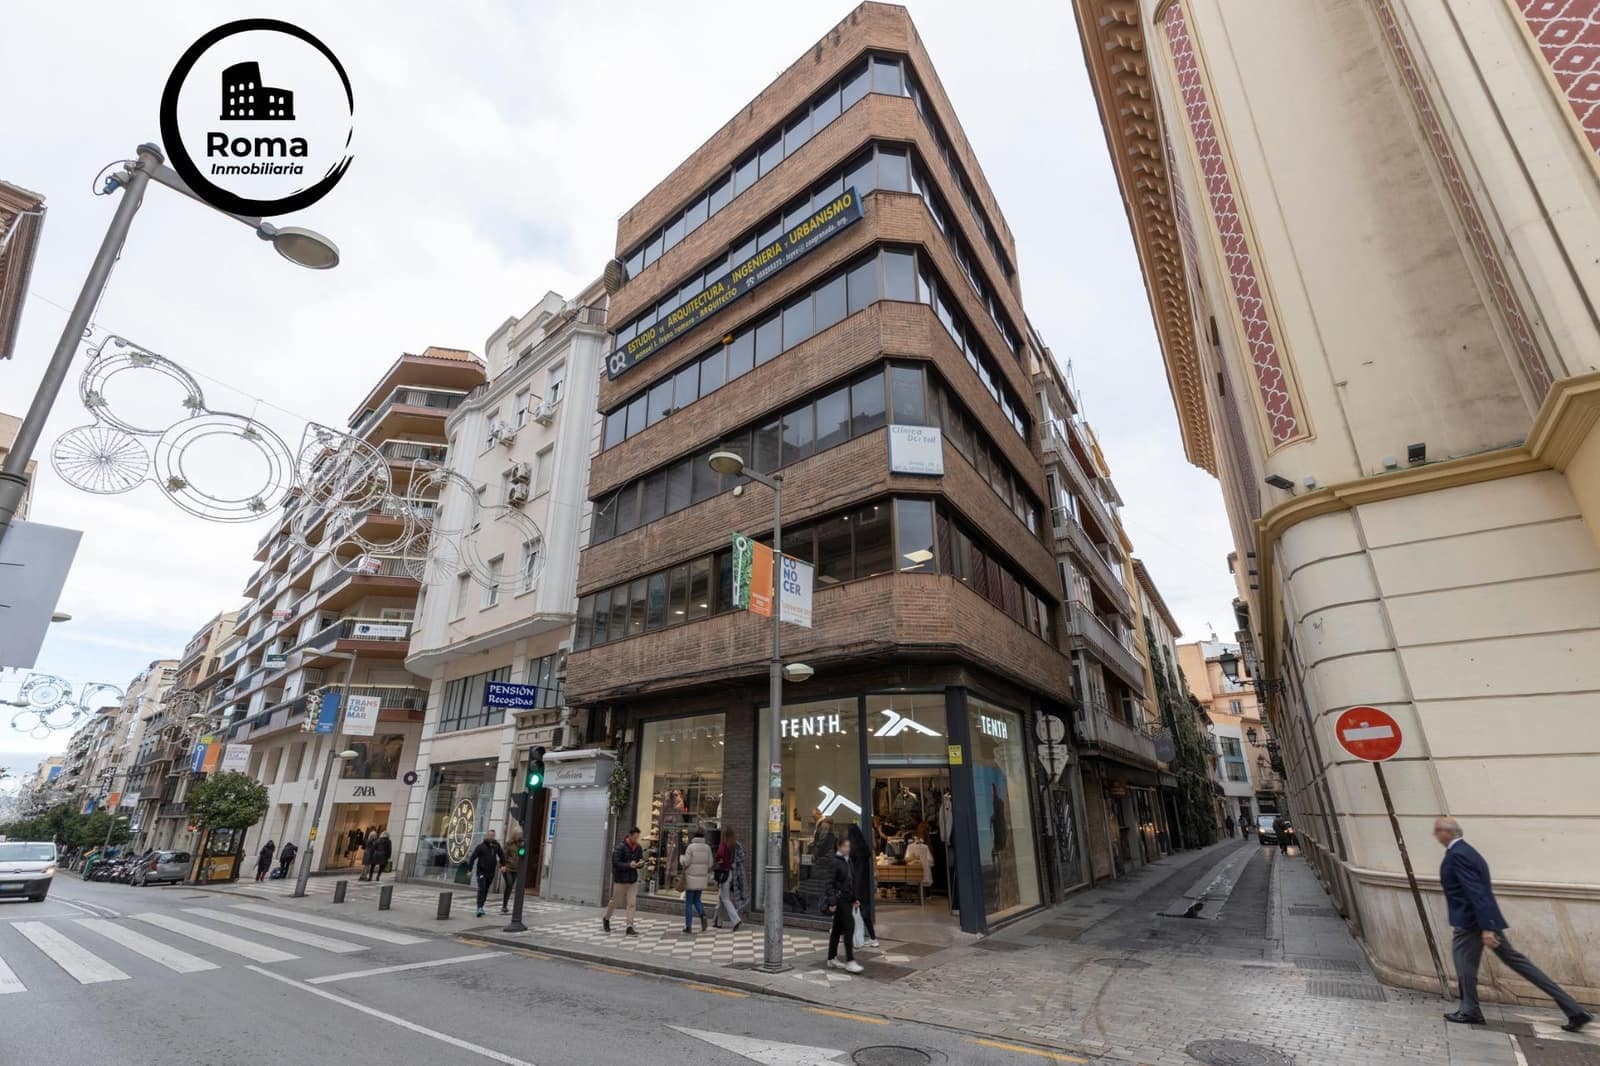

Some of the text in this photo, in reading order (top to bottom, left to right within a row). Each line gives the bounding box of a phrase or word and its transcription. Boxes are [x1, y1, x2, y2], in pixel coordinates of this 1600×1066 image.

[628, 328, 656, 353] ESTUDIO
[732, 242, 783, 283] INGENIERIA
[789, 194, 852, 244] URBANISMO
[783, 568, 798, 582] NO
[783, 580, 801, 596] CER
[489, 684, 535, 696] PENSIÓN
[349, 698, 379, 707] TRANS
[488, 694, 534, 706] Recogidas
[347, 711, 367, 719] MAR
[348, 705, 366, 713] FOR
[781, 714, 840, 737] TENTH
[981, 715, 1008, 739] TENTH
[352, 785, 376, 796] ZARA
